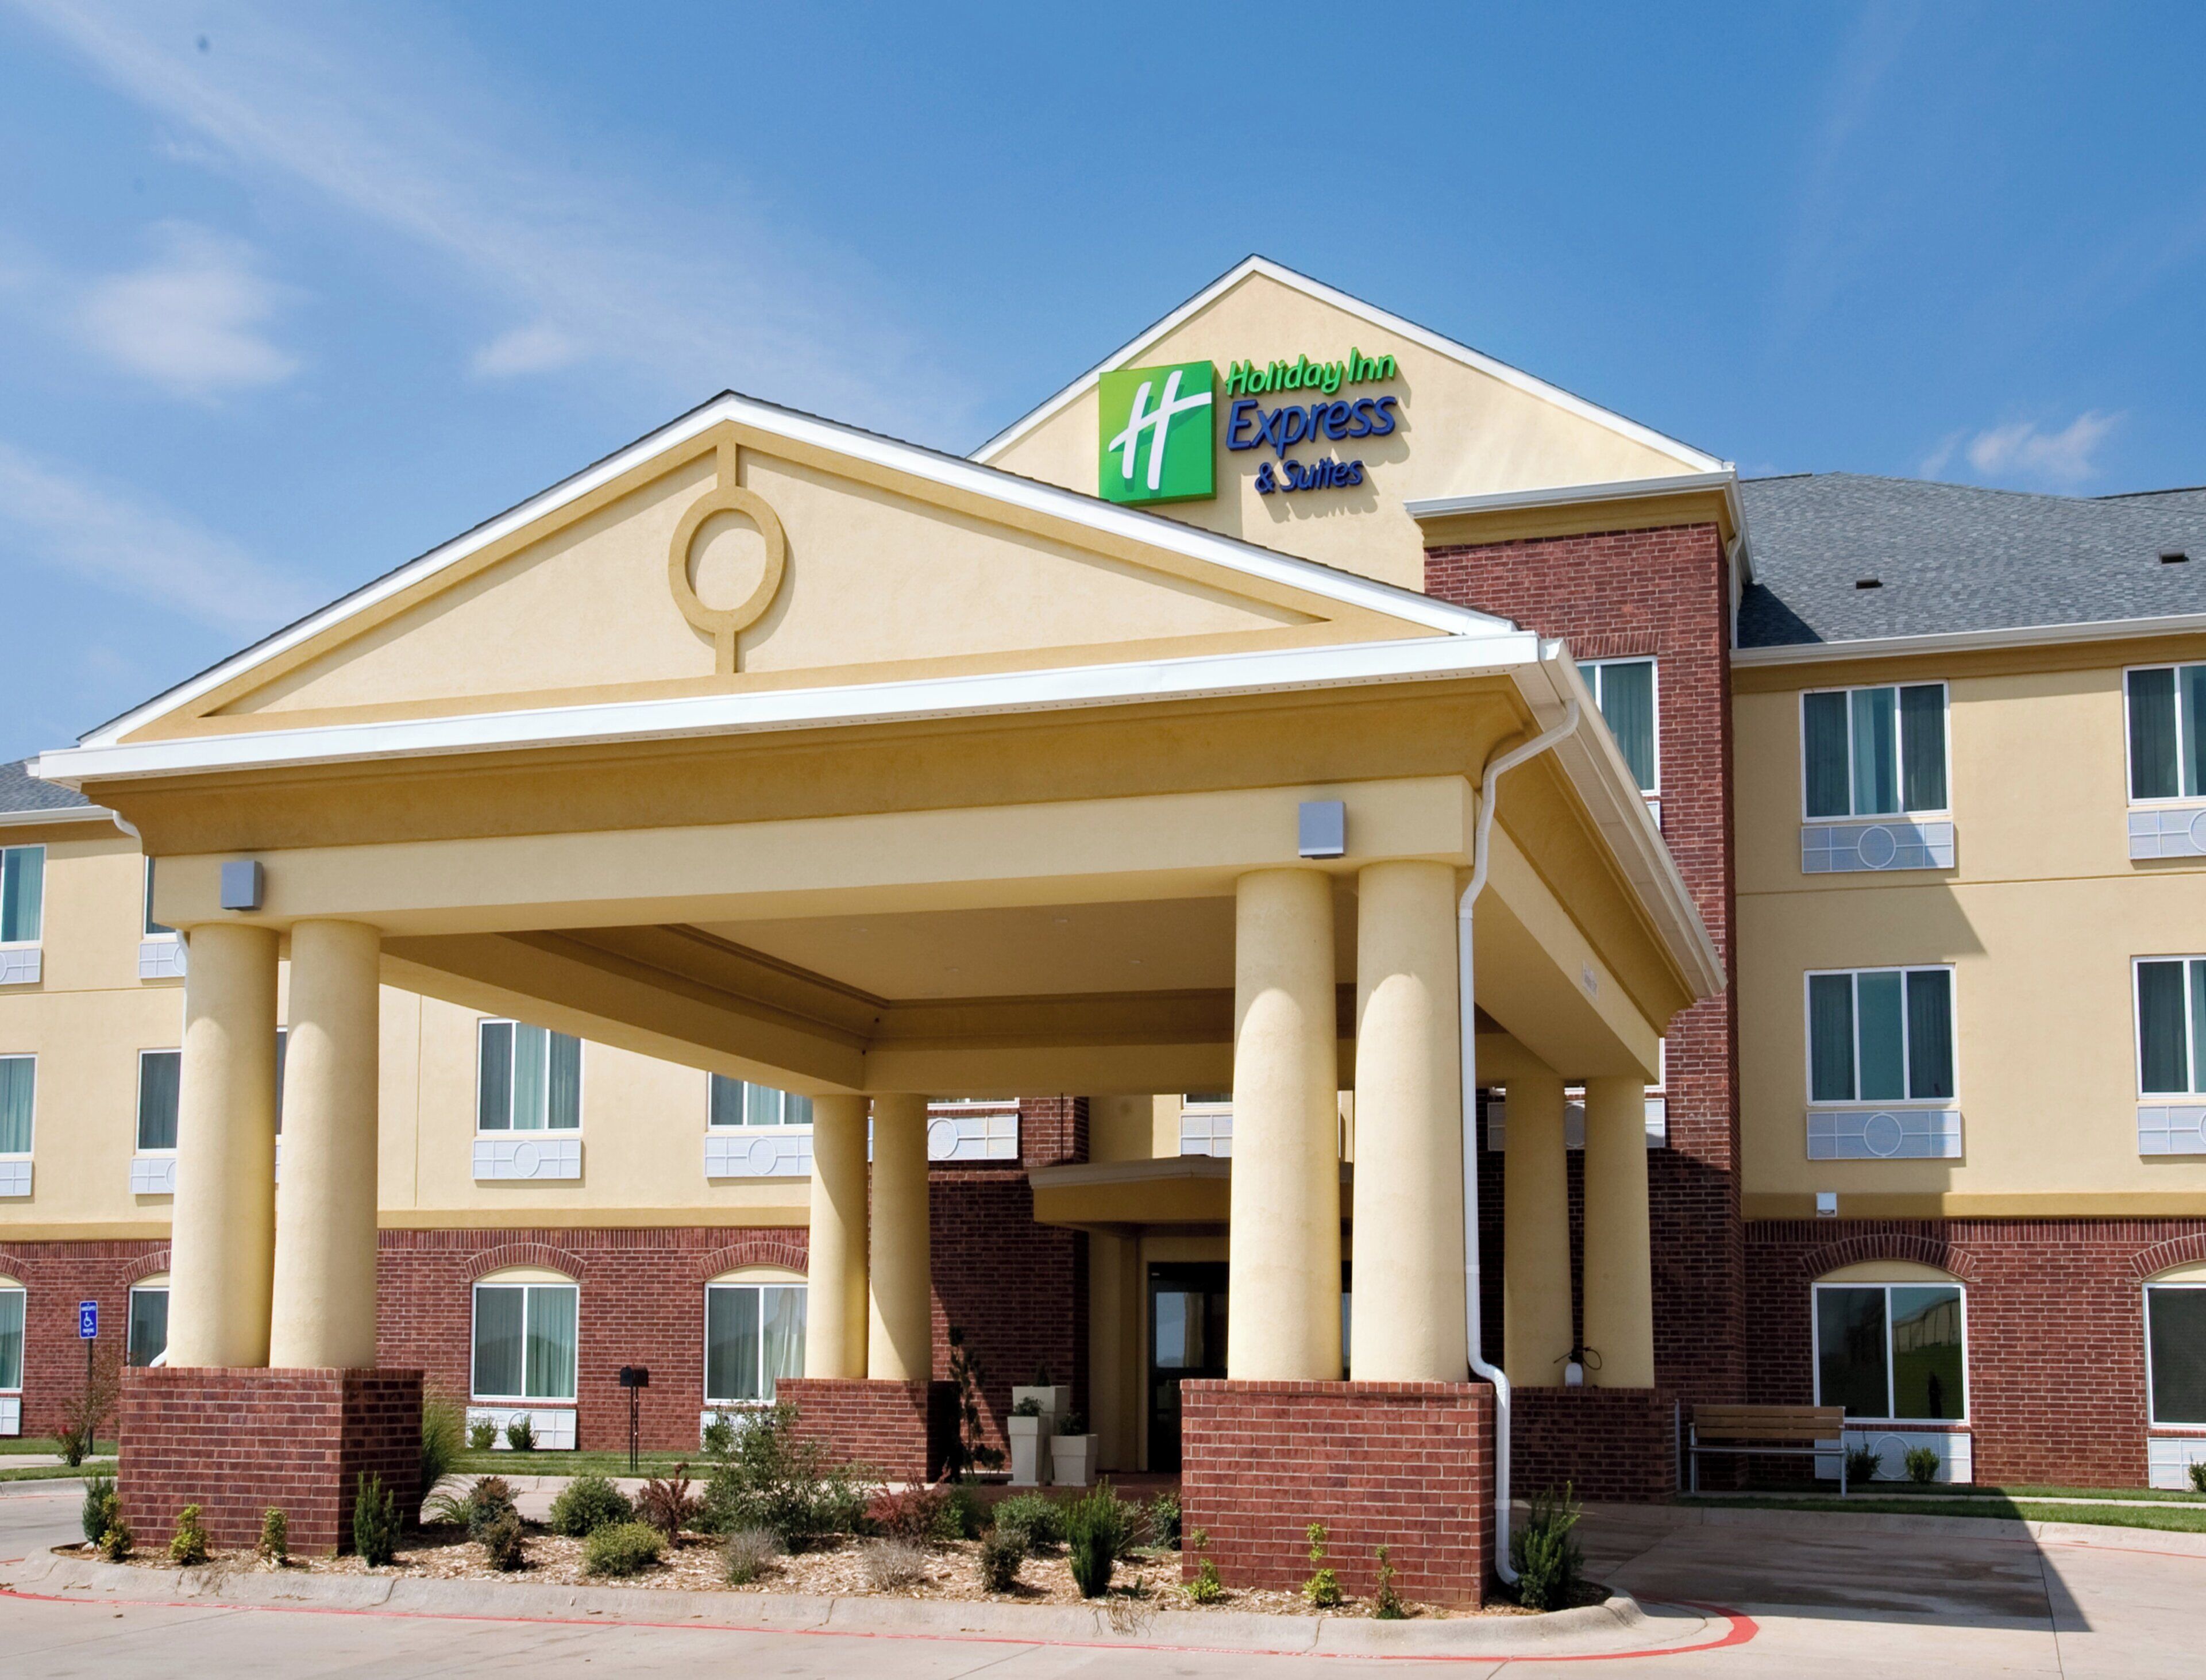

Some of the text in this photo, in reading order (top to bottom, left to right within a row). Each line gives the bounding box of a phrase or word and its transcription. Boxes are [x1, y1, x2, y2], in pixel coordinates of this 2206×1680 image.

[1225, 346, 1395, 396] Holiday Inn
[1226, 395, 1397, 458] Express
[1255, 457, 1363, 494] & Suites
